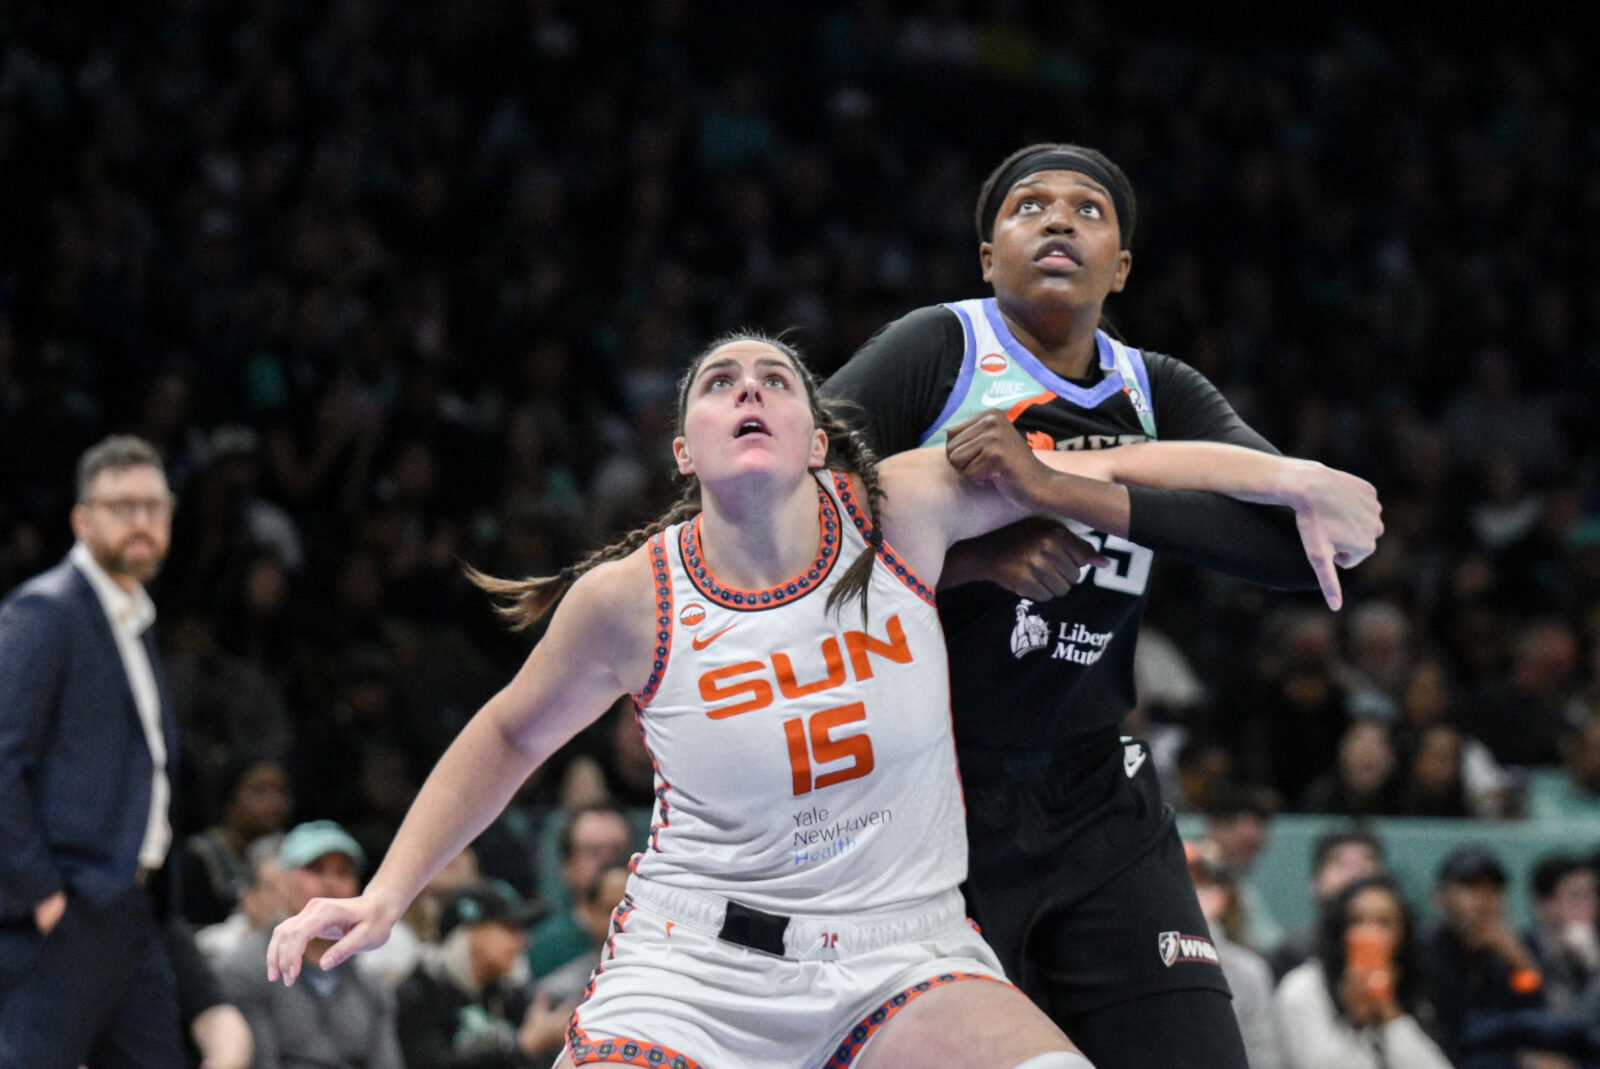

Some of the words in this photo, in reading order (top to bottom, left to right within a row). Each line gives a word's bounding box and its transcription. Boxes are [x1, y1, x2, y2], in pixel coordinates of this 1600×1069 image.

[990, 381, 1024, 396] NIKE
[698, 614, 913, 720] SUN
[783, 701, 875, 796] 15
[793, 806, 829, 828] Yale
[793, 809, 893, 847] NewHaven
[794, 836, 857, 866] Health
